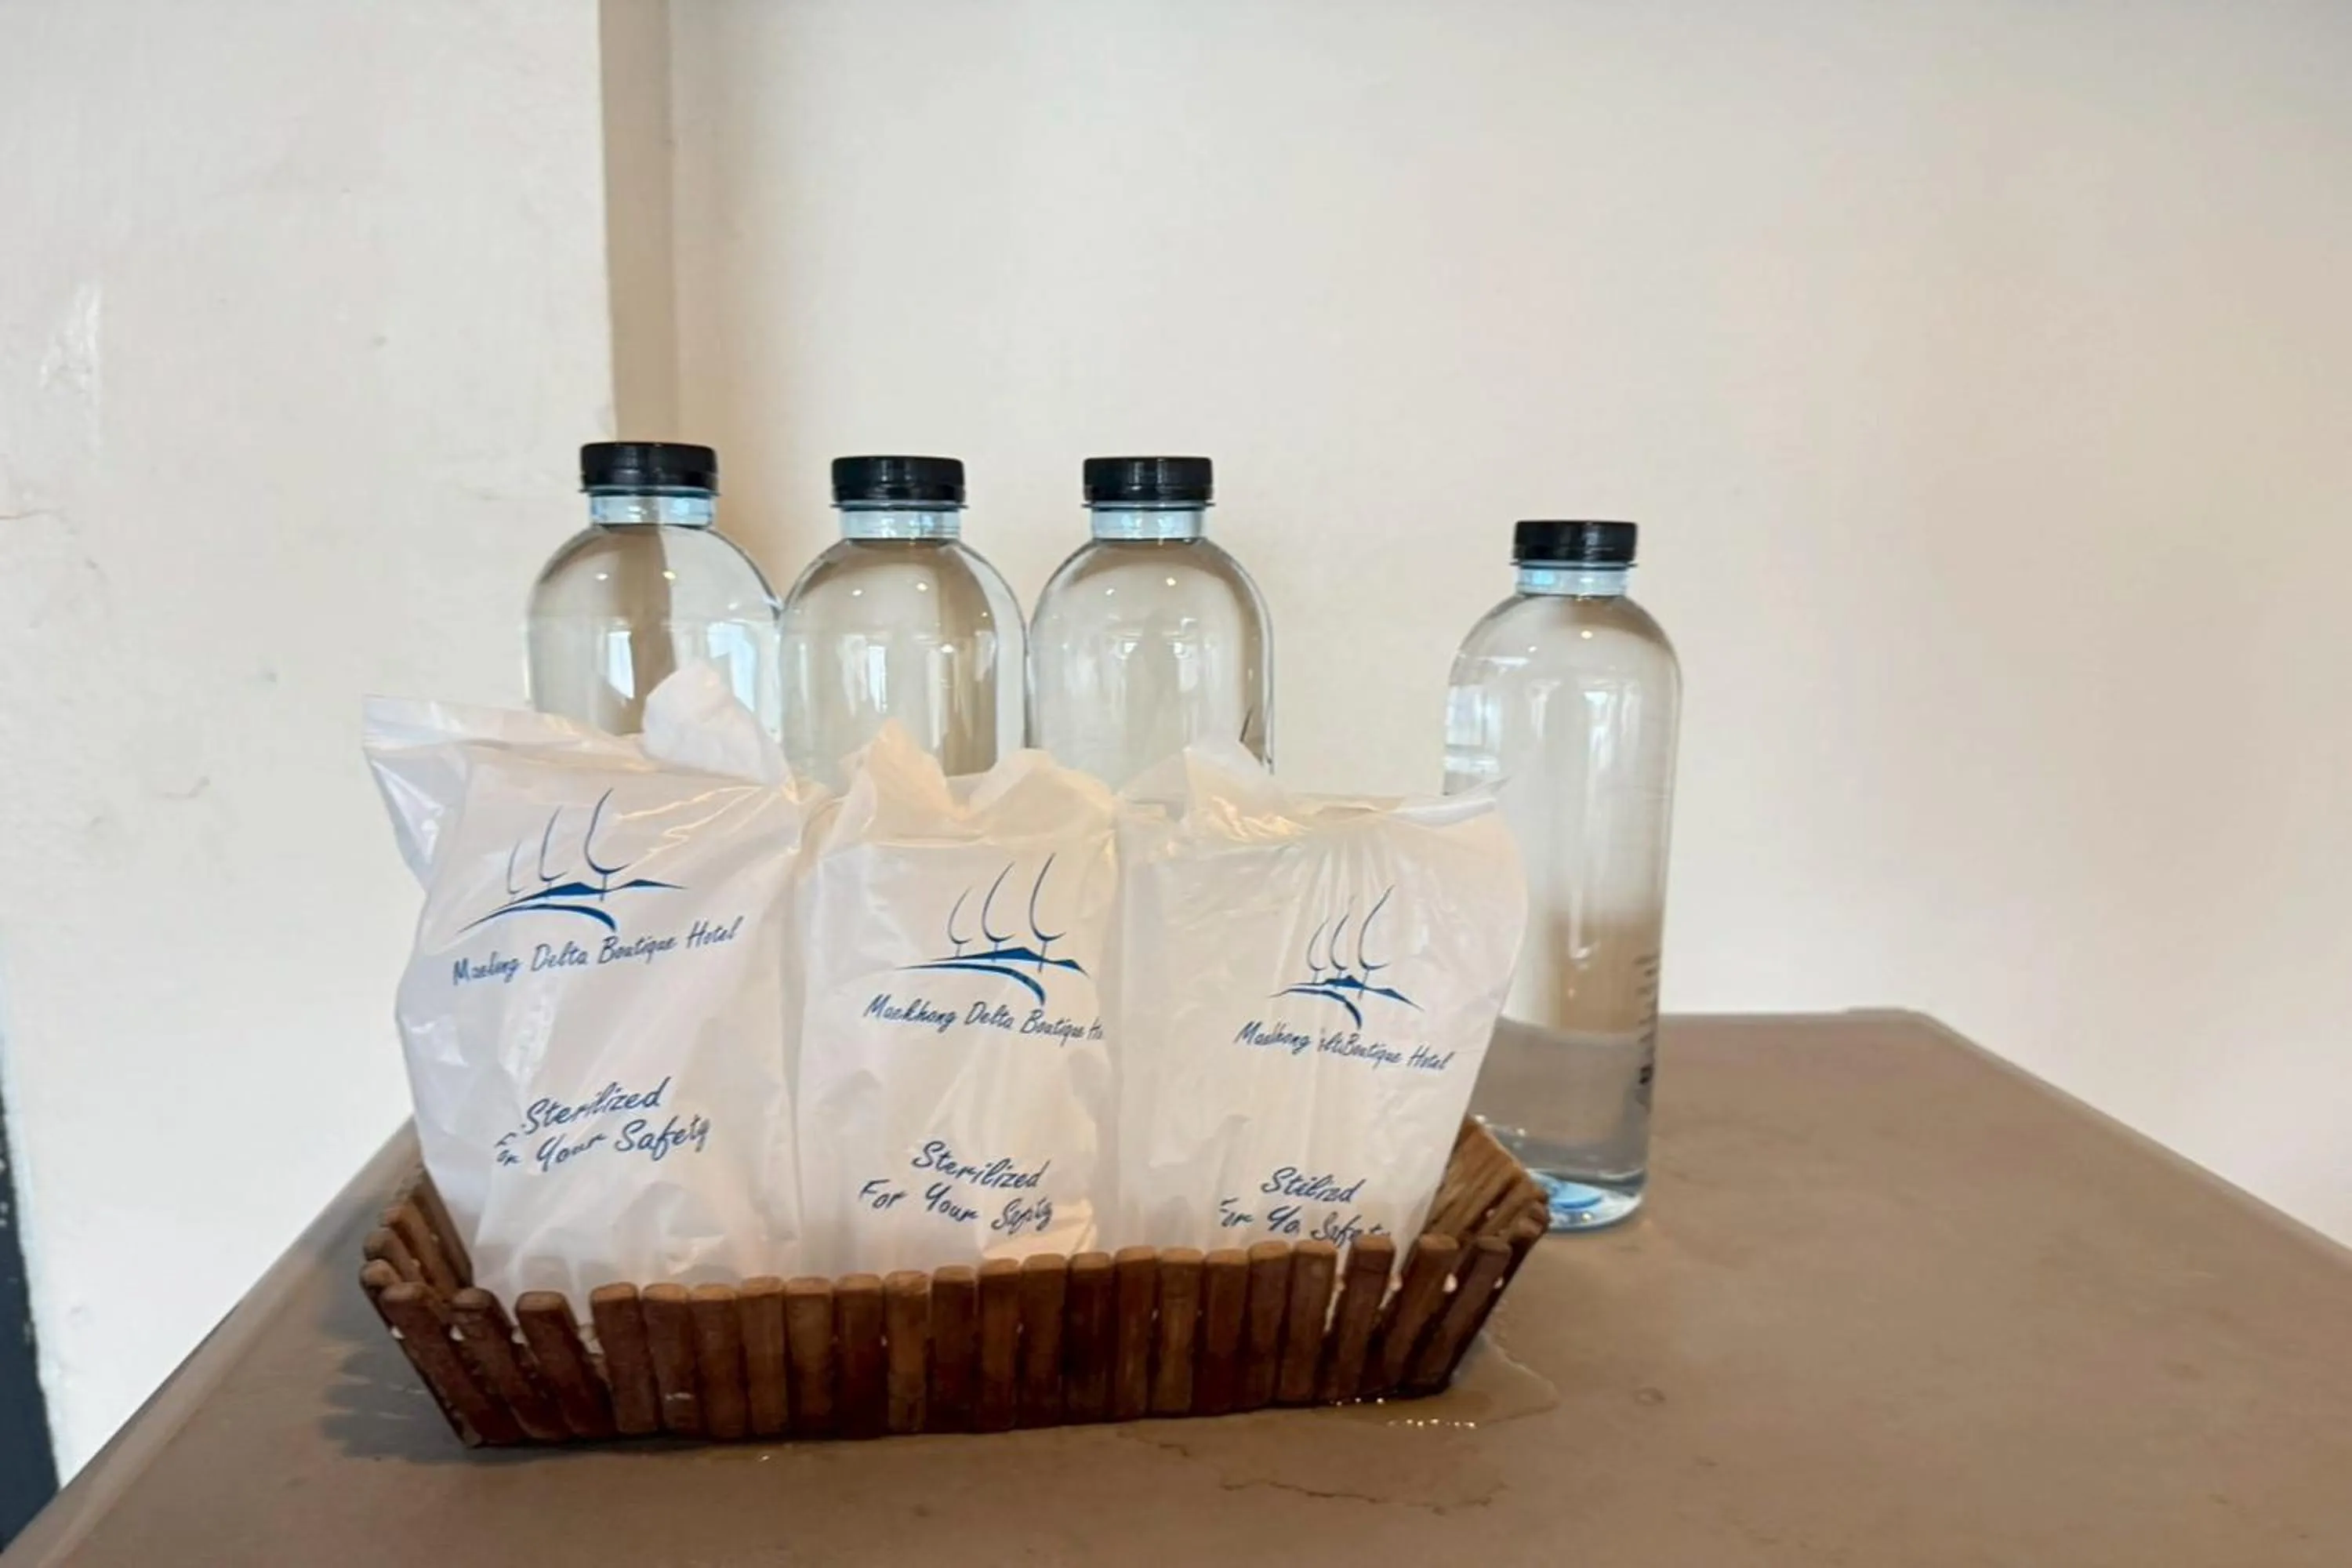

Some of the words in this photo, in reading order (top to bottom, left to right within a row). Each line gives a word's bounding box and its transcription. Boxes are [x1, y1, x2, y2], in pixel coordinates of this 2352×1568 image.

[531, 941, 589, 972] Delta
[597, 935, 677, 964] Boutique
[686, 915, 744, 949] Hotel
[964, 1001, 1015, 1031] Delta
[1406, 1044, 1456, 1071] Hotel
[521, 1075, 672, 1135] Sterilized
[536, 1133, 608, 1173] Your
[912, 1141, 1052, 1189] Sterilized
[859, 1179, 908, 1209] For
[925, 1182, 979, 1222] Your
